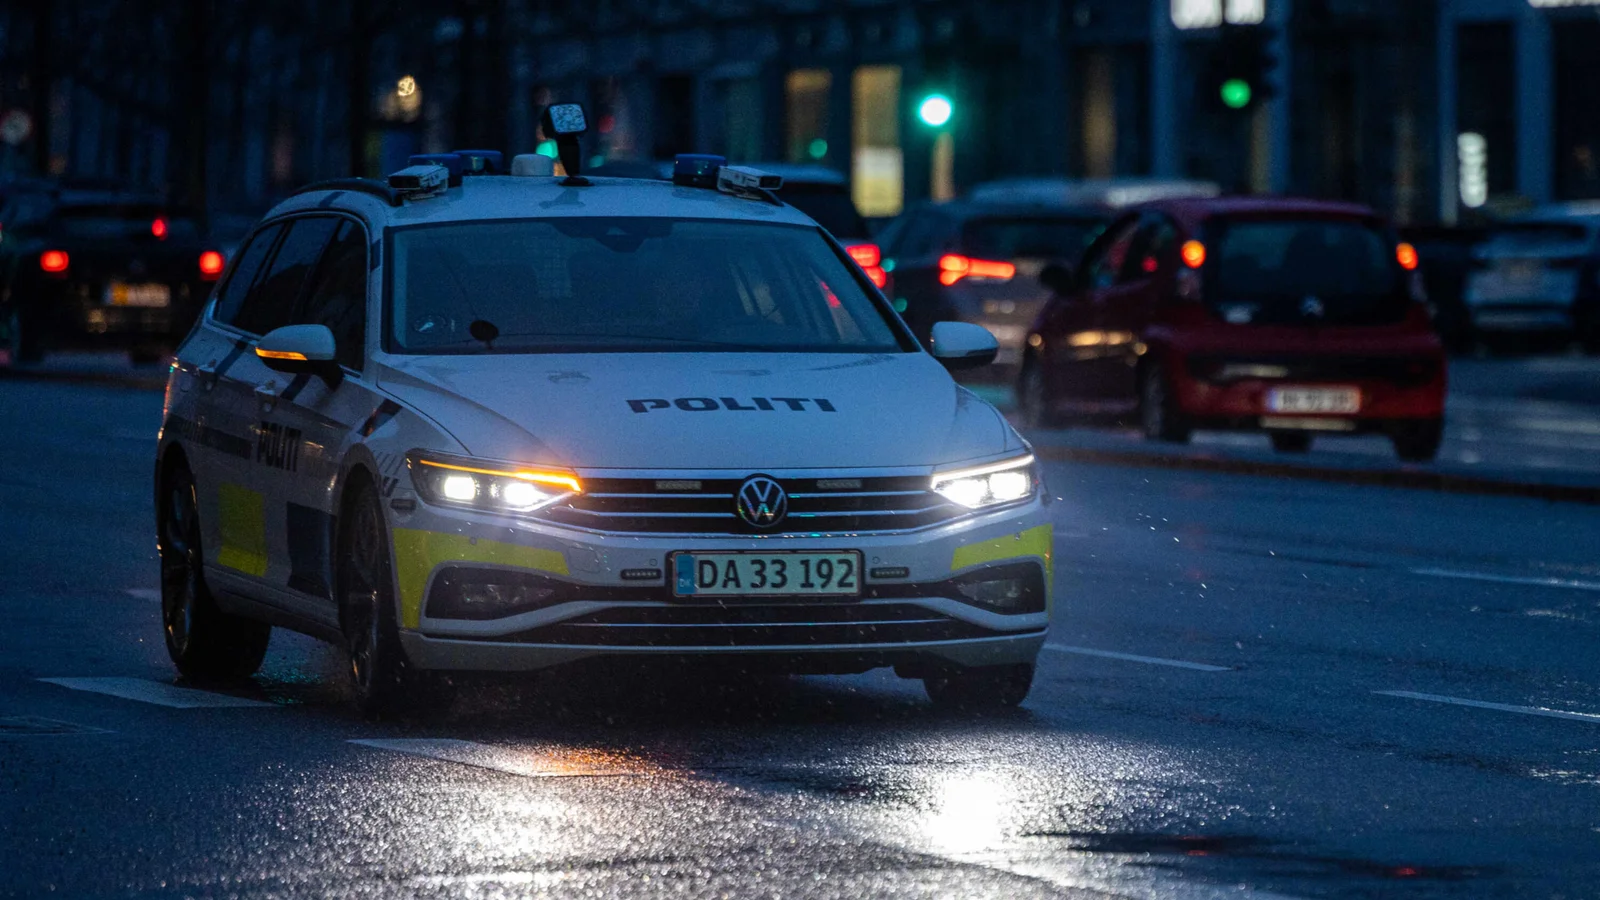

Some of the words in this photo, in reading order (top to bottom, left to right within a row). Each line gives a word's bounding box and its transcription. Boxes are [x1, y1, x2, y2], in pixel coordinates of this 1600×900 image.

[626, 397, 837, 413] POLITI
[257, 421, 301, 471] POLITI
[698, 559, 741, 588] DA
[751, 559, 788, 588] 33
[800, 558, 854, 588] 192
